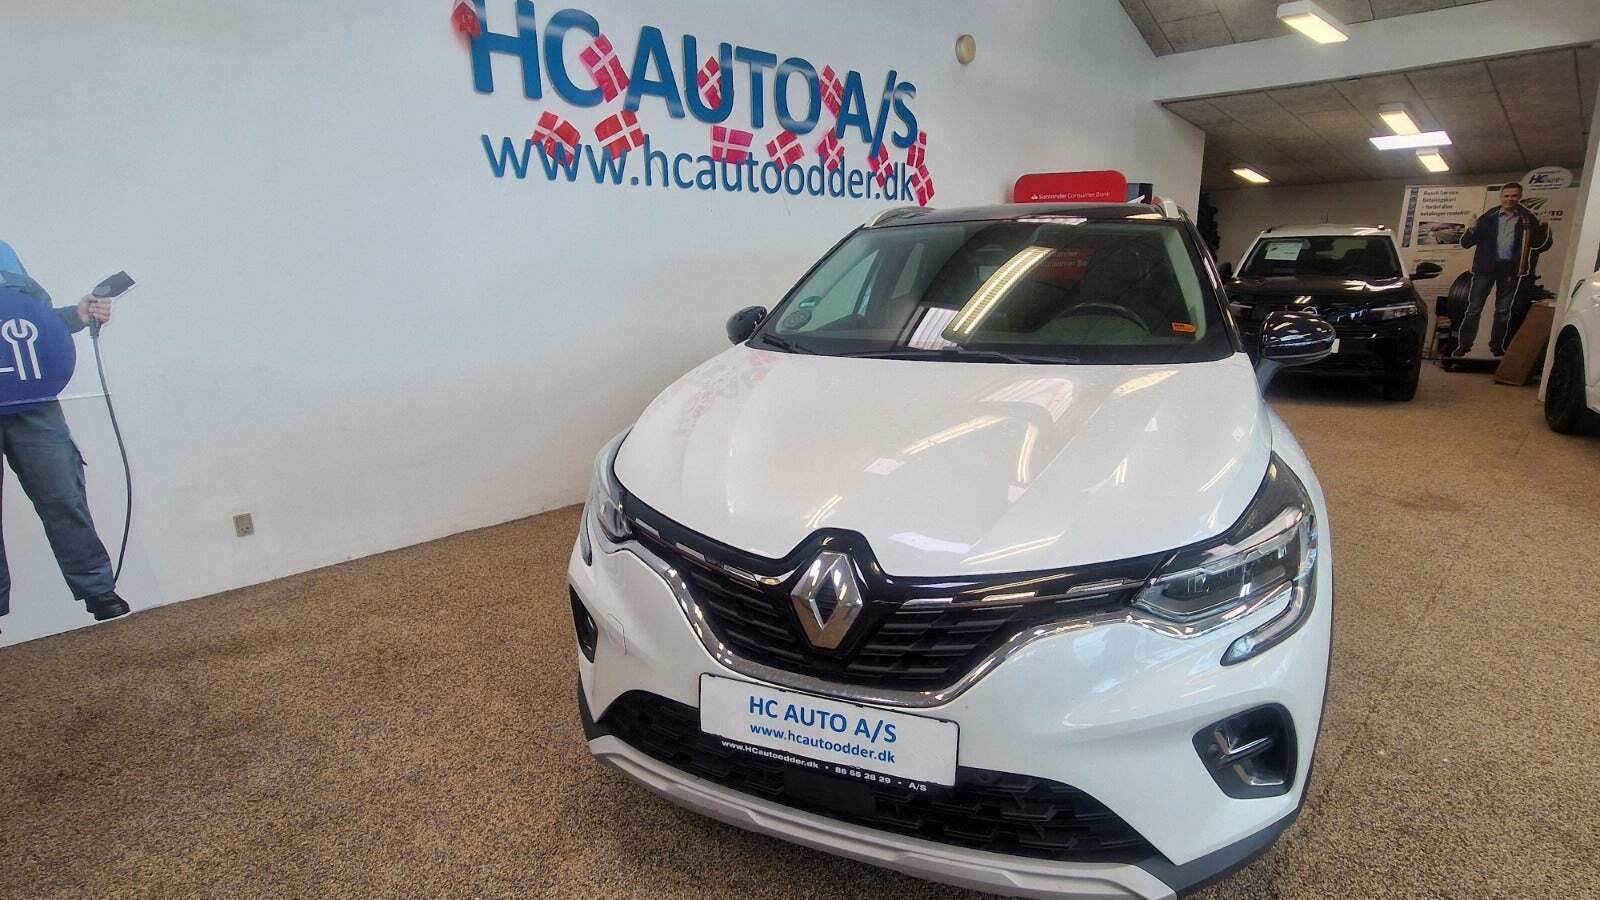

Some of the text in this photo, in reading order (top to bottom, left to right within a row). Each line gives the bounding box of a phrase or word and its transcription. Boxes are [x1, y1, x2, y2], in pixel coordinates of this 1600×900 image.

[470, 0, 919, 158] HC AUTO A/S
[480, 133, 915, 203] www.hcautoodder.dk
[749, 695, 897, 743] HC AUTO A/S
[750, 724, 895, 764] www.hcautoodder.dk
[908, 782, 928, 792] A/S
